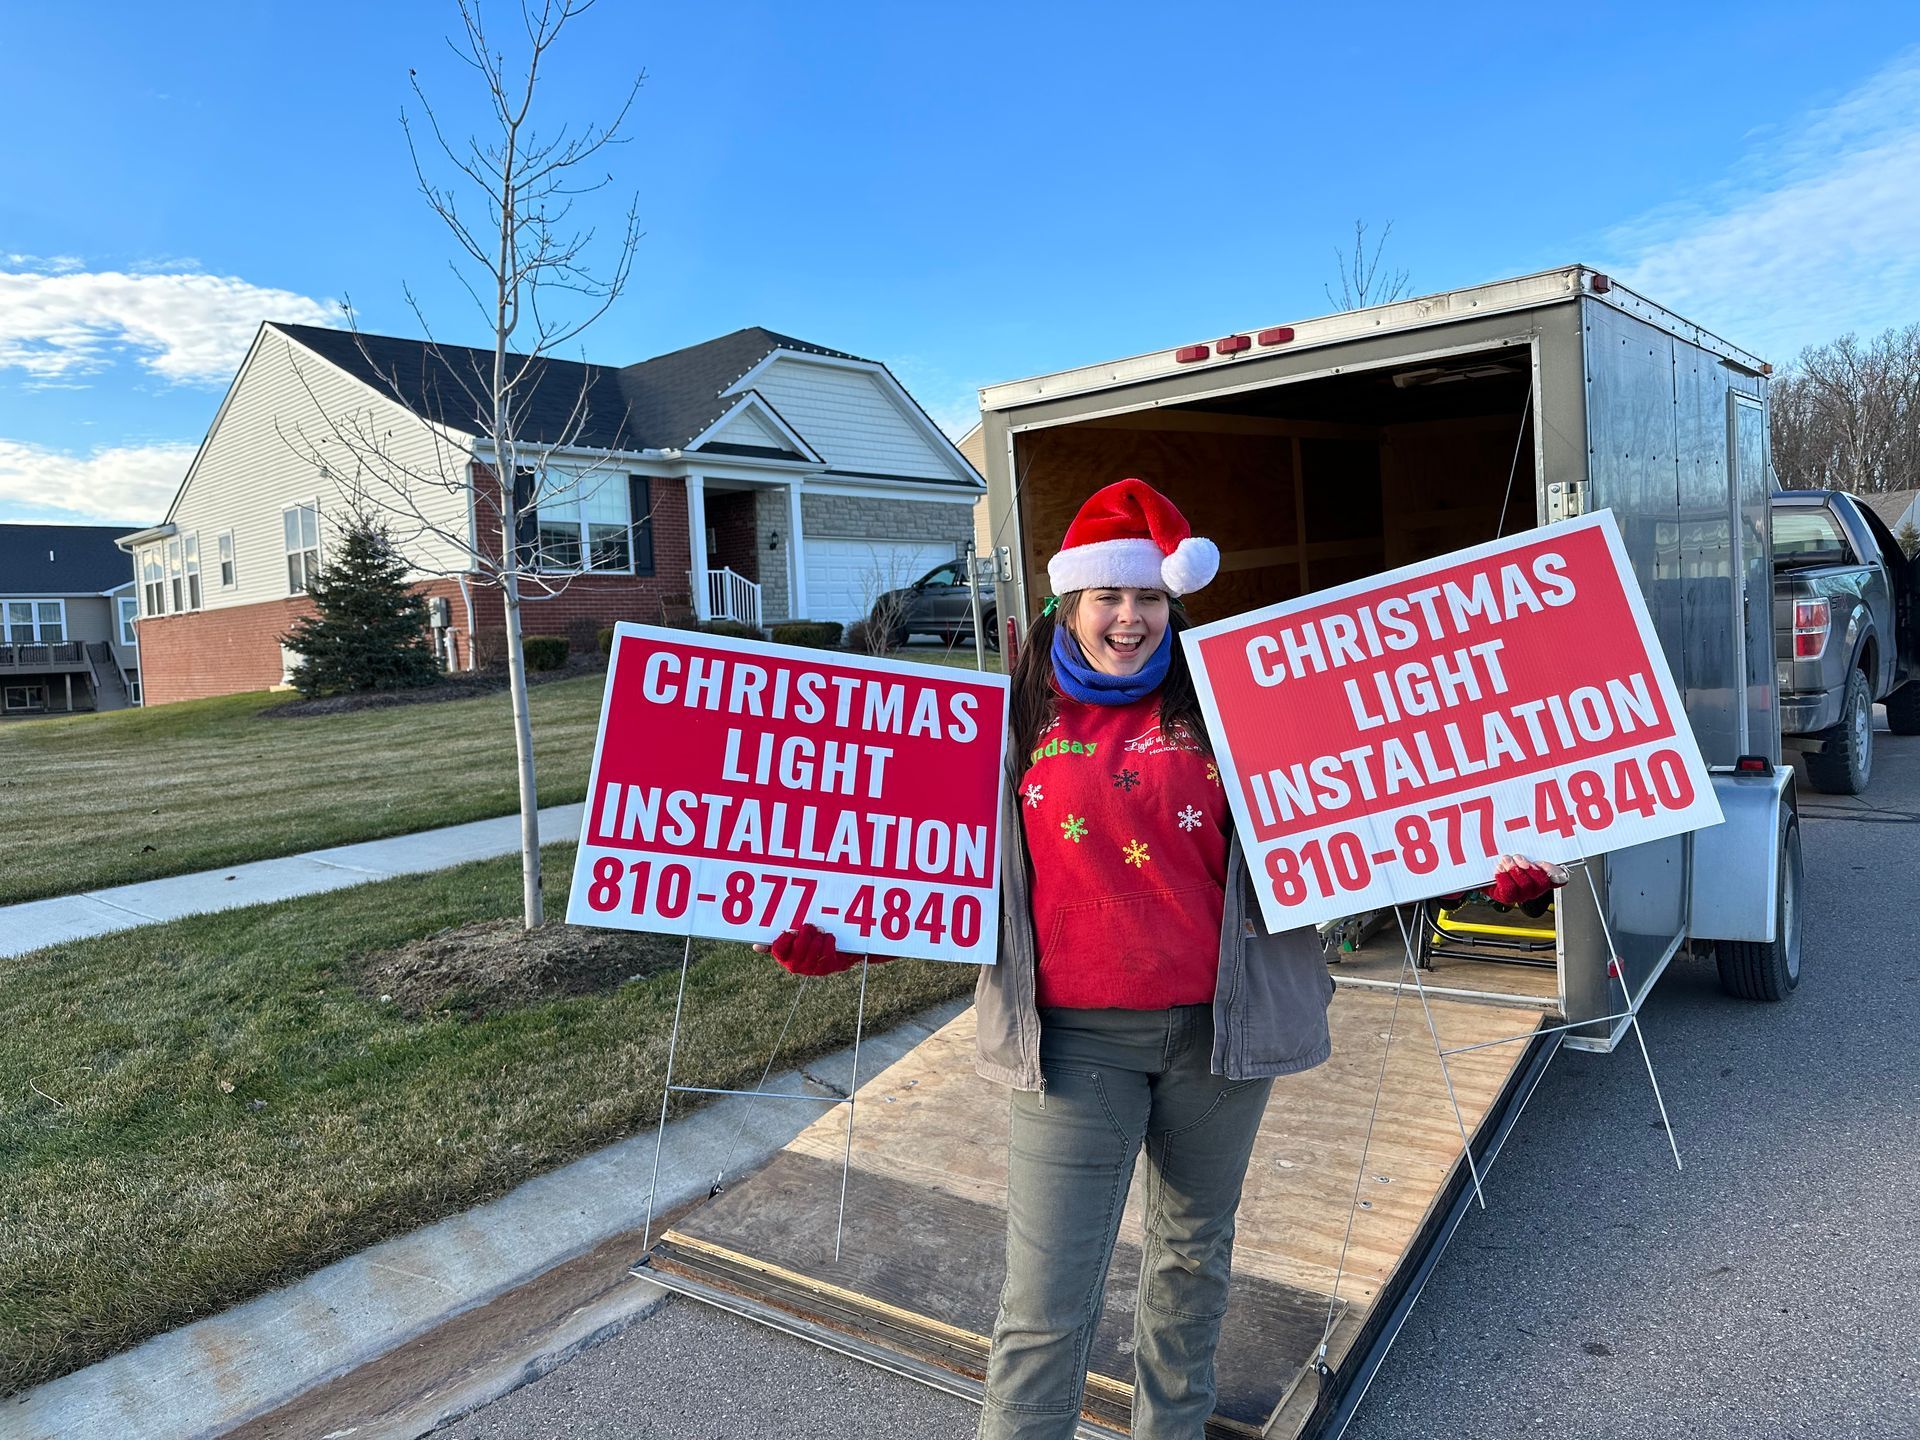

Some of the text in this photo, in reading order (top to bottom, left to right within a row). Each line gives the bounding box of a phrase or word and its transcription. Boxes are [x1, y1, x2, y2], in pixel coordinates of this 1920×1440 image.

[1245, 552, 1577, 688] CHRISTMAS
[642, 651, 979, 743] CHRISTMAS
[1343, 639, 1510, 732] LIGHT
[721, 728, 894, 799] LIGHT
[1149, 745, 1178, 755] HOLIDAY
[1249, 672, 1660, 827] INSTALLATION
[598, 782, 988, 879] INSTALLATION
[1264, 748, 1696, 907] 810-877-4840
[587, 856, 982, 949] 810-877-4840
